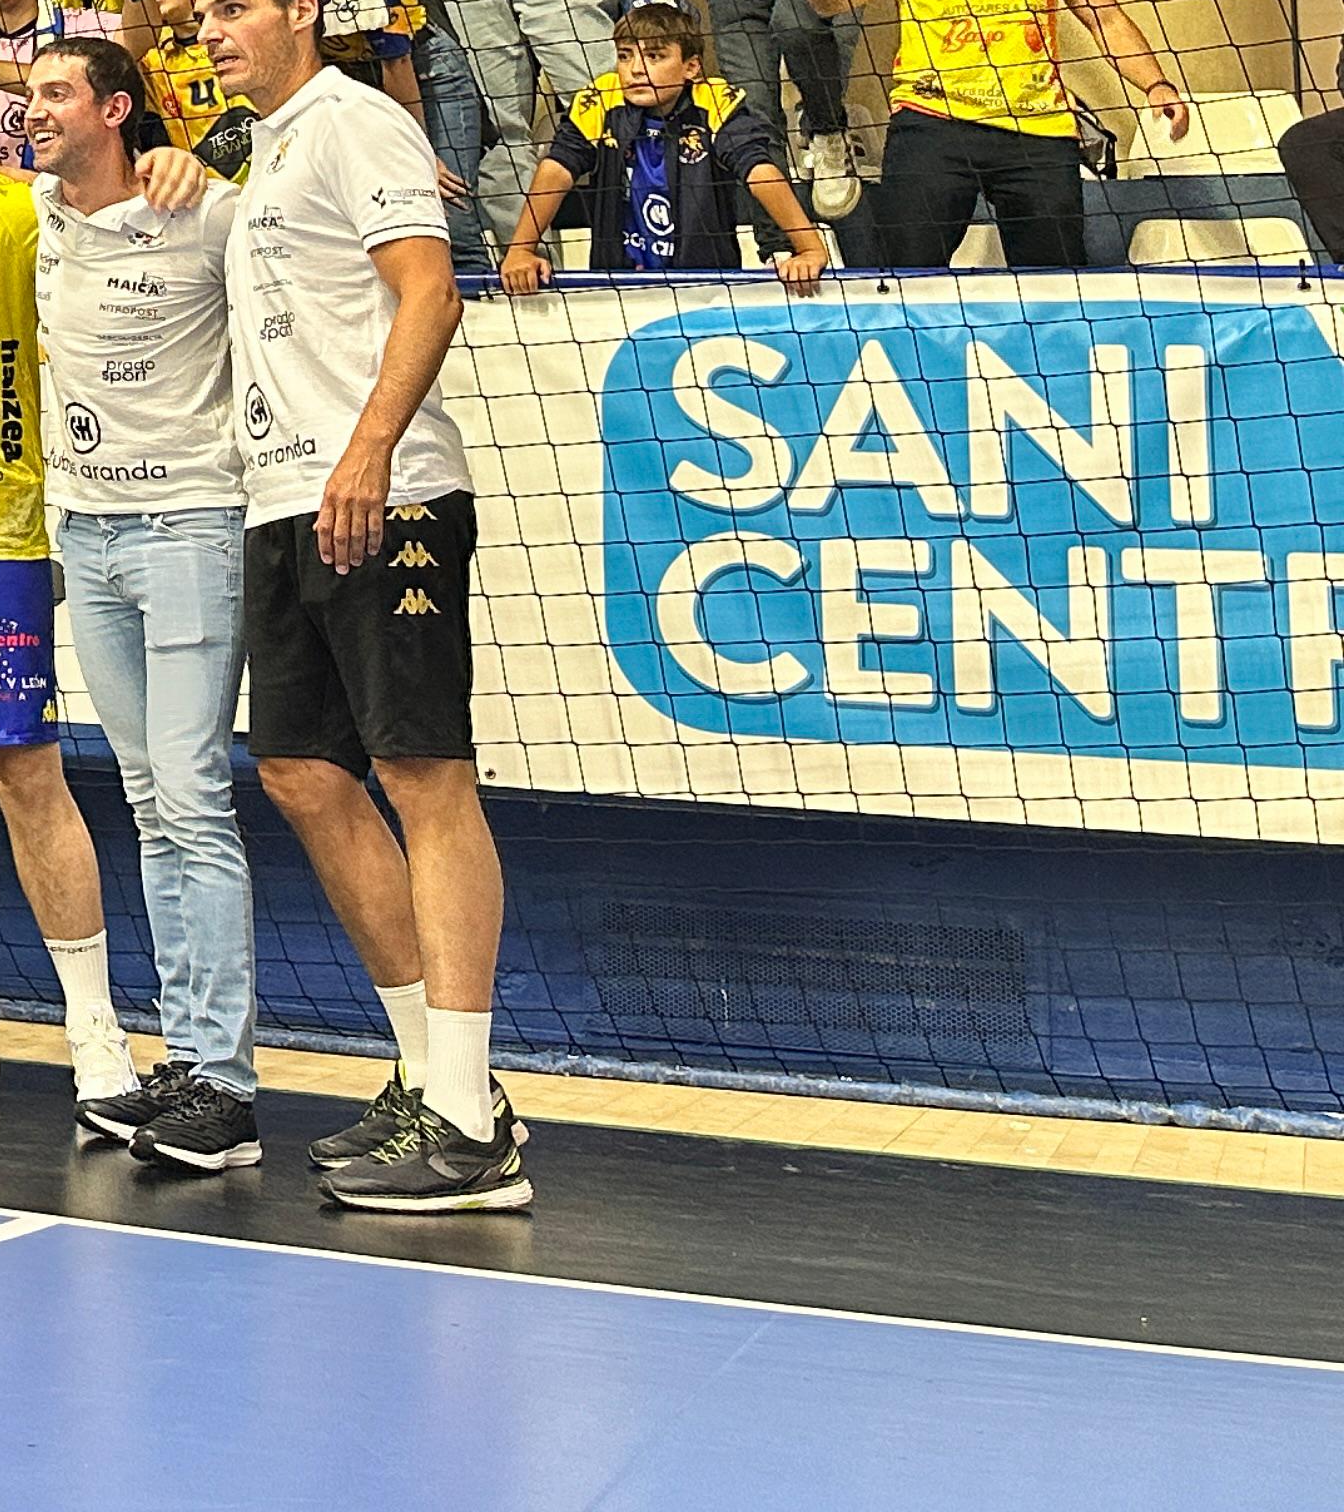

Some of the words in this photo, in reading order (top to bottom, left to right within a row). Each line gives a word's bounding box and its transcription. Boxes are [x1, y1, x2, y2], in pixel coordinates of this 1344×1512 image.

[101, 366, 148, 383] sport
[106, 357, 156, 373] prado
[668, 335, 1217, 528] SANI
[257, 432, 316, 470] aranda
[80, 459, 169, 482] aranda
